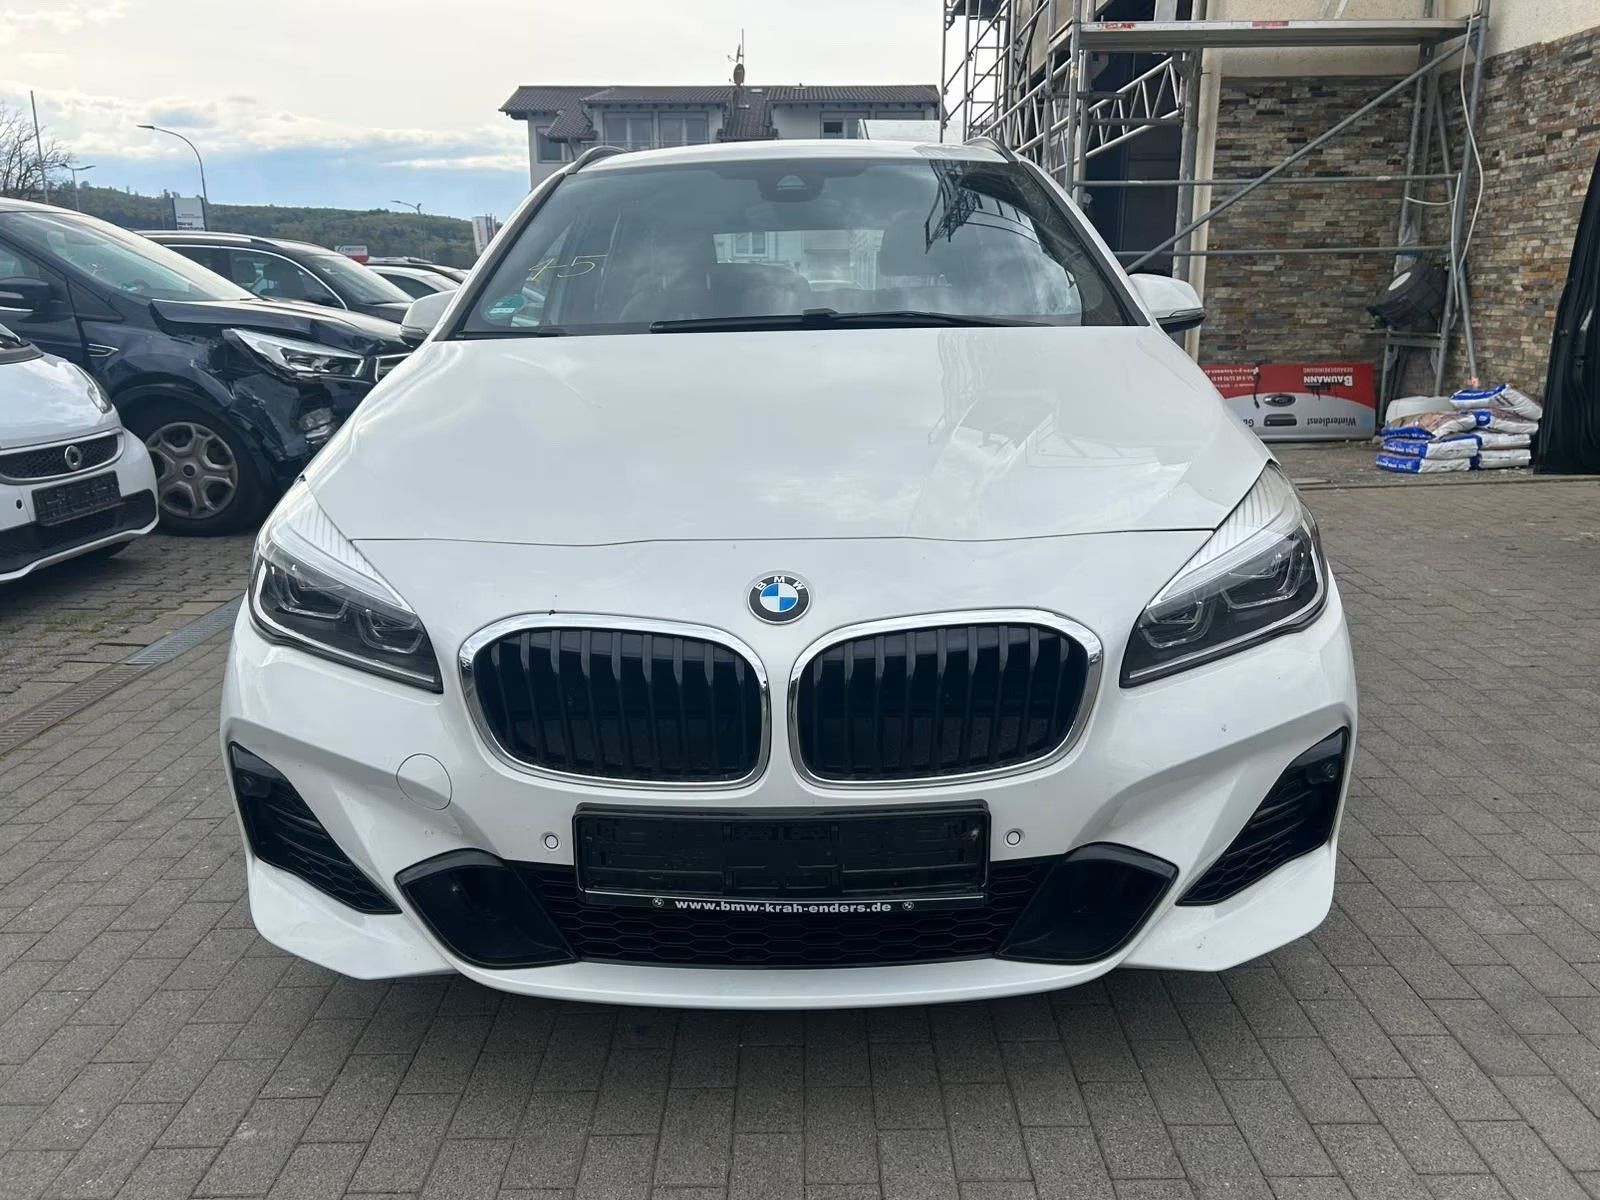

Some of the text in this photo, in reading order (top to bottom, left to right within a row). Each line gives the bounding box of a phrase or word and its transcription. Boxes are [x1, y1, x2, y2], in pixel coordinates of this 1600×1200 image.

[1303, 375, 1353, 387] BAUMANN
[1307, 416, 1356, 427] Winterdienst
[675, 900, 892, 914] www.bmw-krah-enders.de
